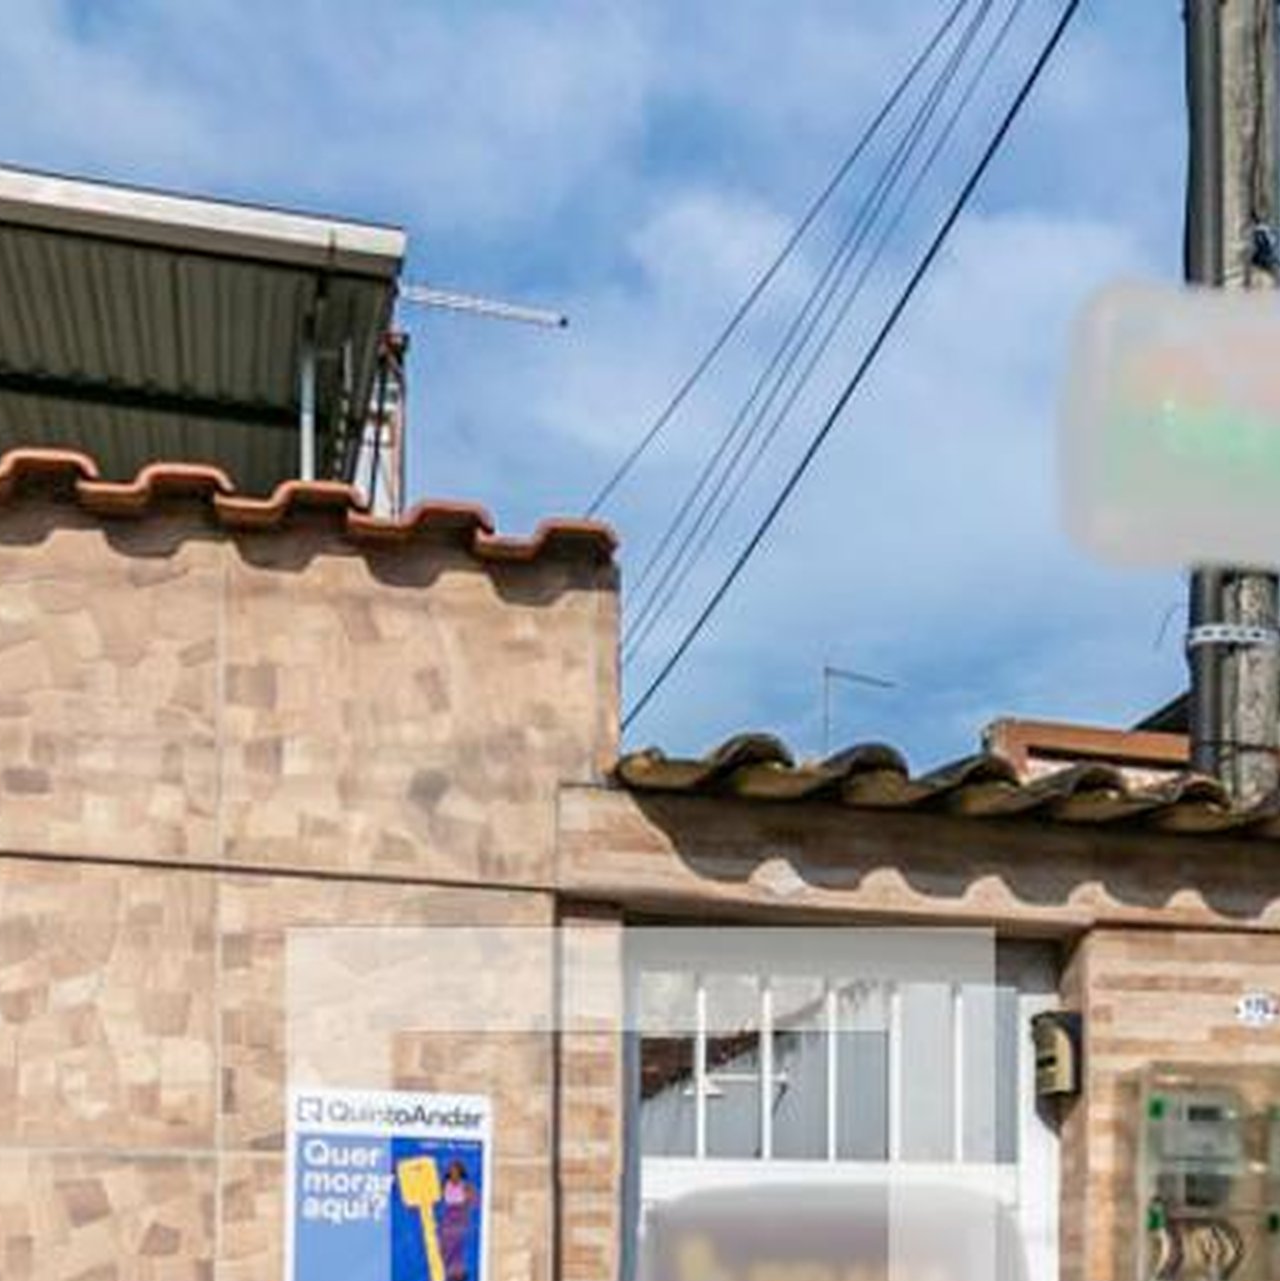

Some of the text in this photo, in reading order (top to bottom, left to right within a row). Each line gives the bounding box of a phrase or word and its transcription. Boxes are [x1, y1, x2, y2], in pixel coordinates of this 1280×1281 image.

[326, 1099, 482, 1128] QuintoAndar
[303, 1139, 384, 1167] Quer
[303, 1171, 395, 1194] morar
[303, 1194, 389, 1225] aqui?
